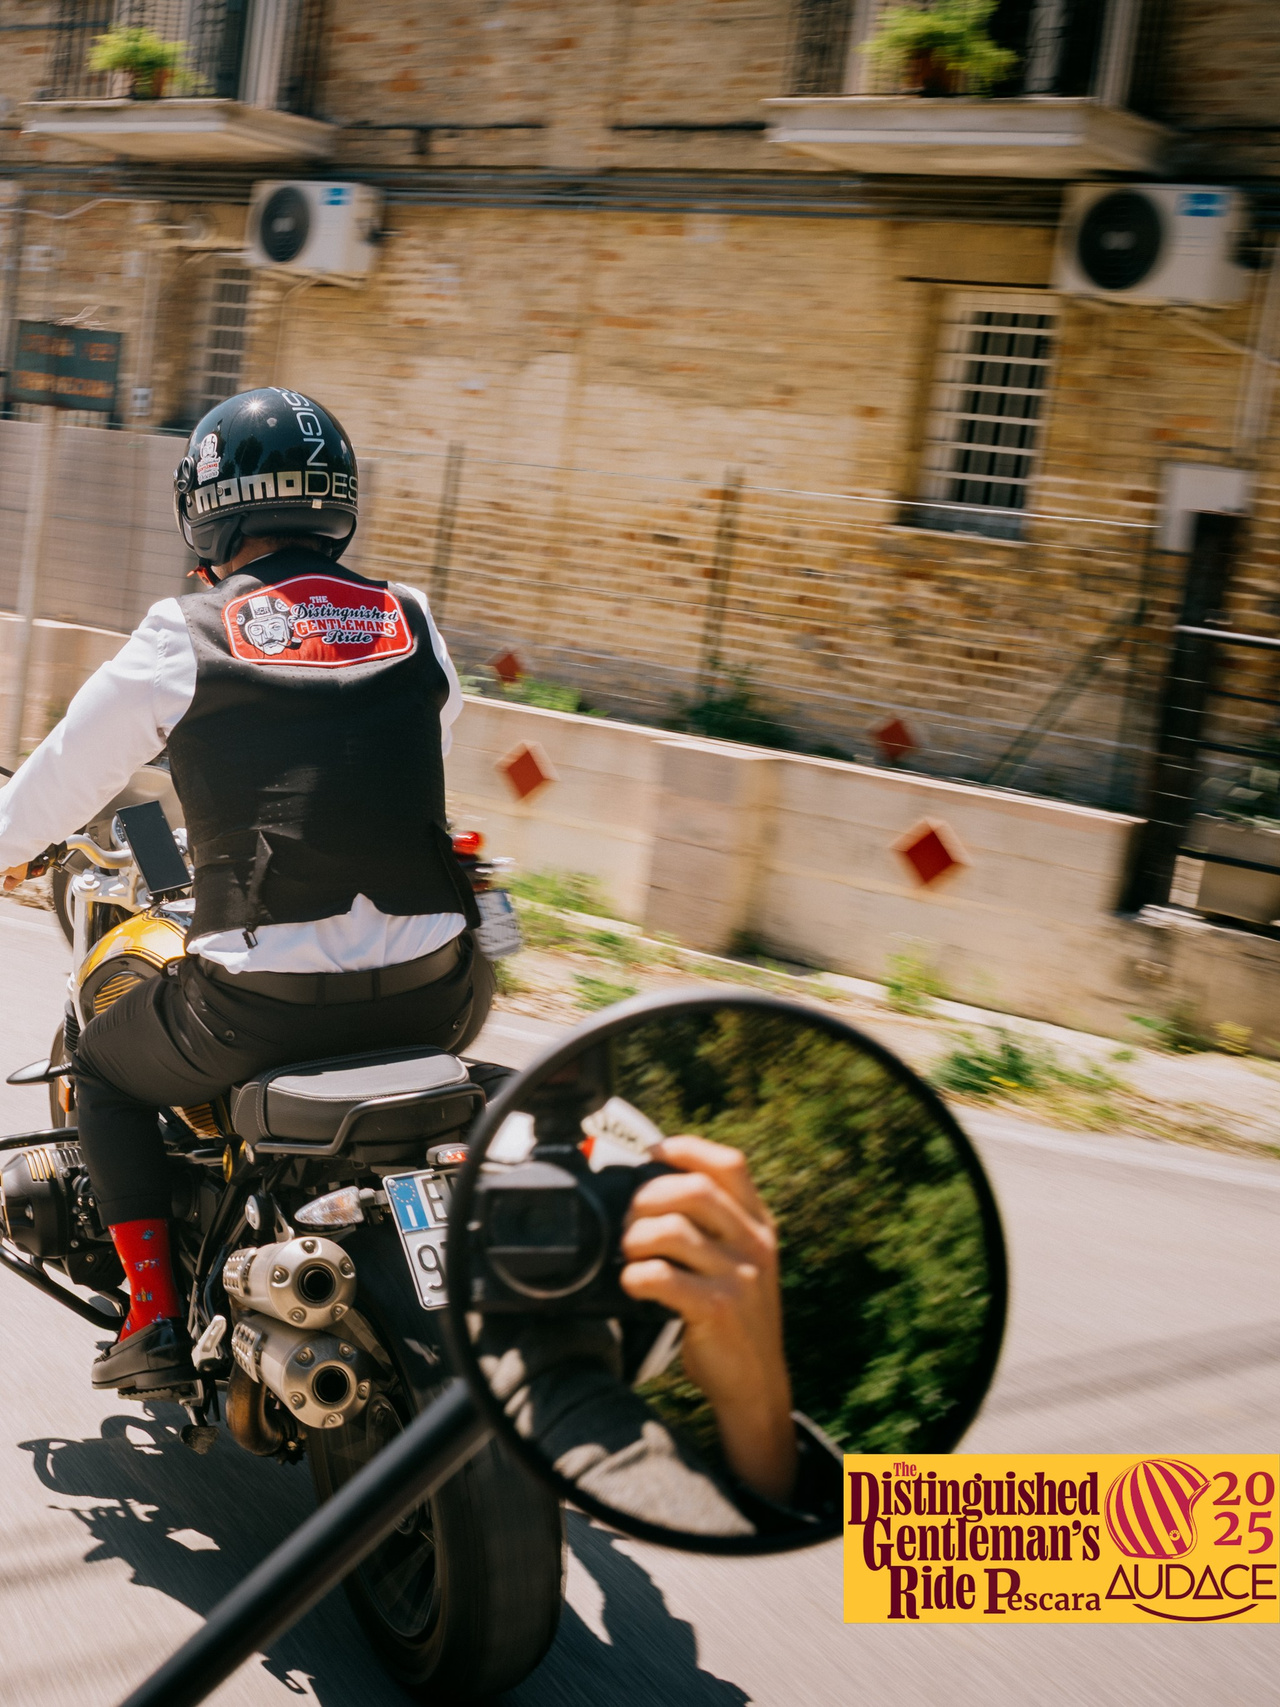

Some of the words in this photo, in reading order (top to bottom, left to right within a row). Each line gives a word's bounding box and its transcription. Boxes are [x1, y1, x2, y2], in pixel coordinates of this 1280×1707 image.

[309, 595, 328, 604] THE
[291, 602, 398, 622] Distinguished
[295, 617, 396, 636] GENTLEMANS
[323, 629, 373, 644] Ride
